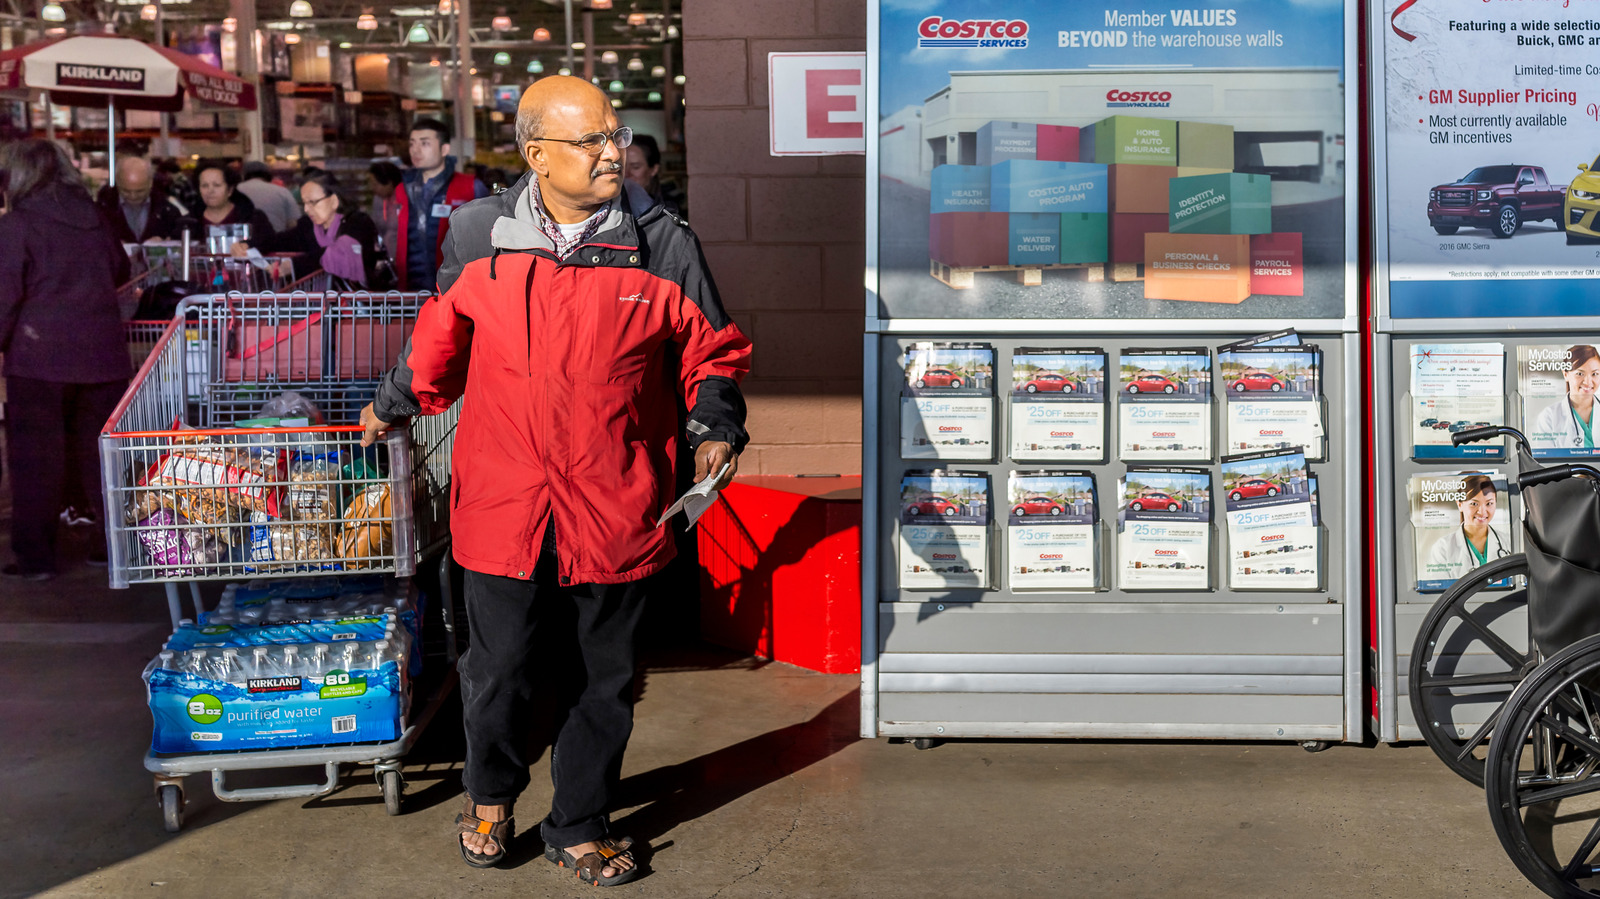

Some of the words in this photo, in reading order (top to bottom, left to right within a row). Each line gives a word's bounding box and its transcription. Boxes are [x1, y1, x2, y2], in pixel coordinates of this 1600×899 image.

[1104, 10, 1166, 27] Member
[1170, 10, 1236, 26] VALUES
[919, 17, 1028, 38] COSTCO
[1449, 20, 1506, 34] Featuring
[1510, 22, 1517, 31] a
[1521, 20, 1550, 31] wide
[979, 39, 1027, 48] SERVICES
[1058, 31, 1128, 48] BEYOND
[1132, 30, 1156, 47] the
[1160, 30, 1242, 47] warehouse
[1246, 30, 1284, 47] walls
[1517, 34, 1554, 48] Buick,
[1558, 34, 1584, 46] GMC
[60, 64, 143, 82] KIRKLAND
[1514, 64, 1582, 76] Limited-time
[1106, 89, 1172, 102] COSTCO
[1429, 90, 1453, 104] GM
[1458, 89, 1520, 107] Supplier
[1525, 88, 1577, 106] Pricing
[805, 69, 864, 139] E
[1429, 115, 1457, 128] Most
[1460, 114, 1512, 130] currently
[1515, 114, 1567, 127] available
[1429, 132, 1449, 144] GM
[1453, 131, 1512, 144] incentives
[1124, 146, 1171, 154] INSURANCE
[952, 190, 983, 198] HEALTH
[1028, 185, 1066, 198] COSTCO
[1068, 182, 1094, 194] AUTO
[944, 198, 990, 206] INSURANCE
[1039, 193, 1086, 206] PROGRAM
[1178, 188, 1216, 209] IDENTITY
[1174, 194, 1226, 220] PROTECTION
[1022, 236, 1051, 244] WATER
[1017, 244, 1056, 252] DELIVERY
[1164, 252, 1210, 262] PERSONAL
[1153, 260, 1194, 270] BUSINESS
[1196, 262, 1231, 271] CHECKS
[1254, 268, 1293, 277] SERVICES
[1528, 349, 1572, 362] MyCostco
[1529, 360, 1572, 372] Services
[934, 404, 950, 412] OFF
[1046, 409, 1062, 417] OFF
[1254, 408, 1270, 416] OFF
[1421, 480, 1466, 493] MyCostco
[1421, 491, 1467, 502] Services
[1253, 514, 1270, 522] OFF
[1034, 532, 1050, 540] OFF
[249, 677, 300, 688] KIRKLAND
[325, 673, 350, 685] 80
[189, 702, 205, 716] 8
[228, 708, 280, 723] purified
[284, 706, 322, 718] water
